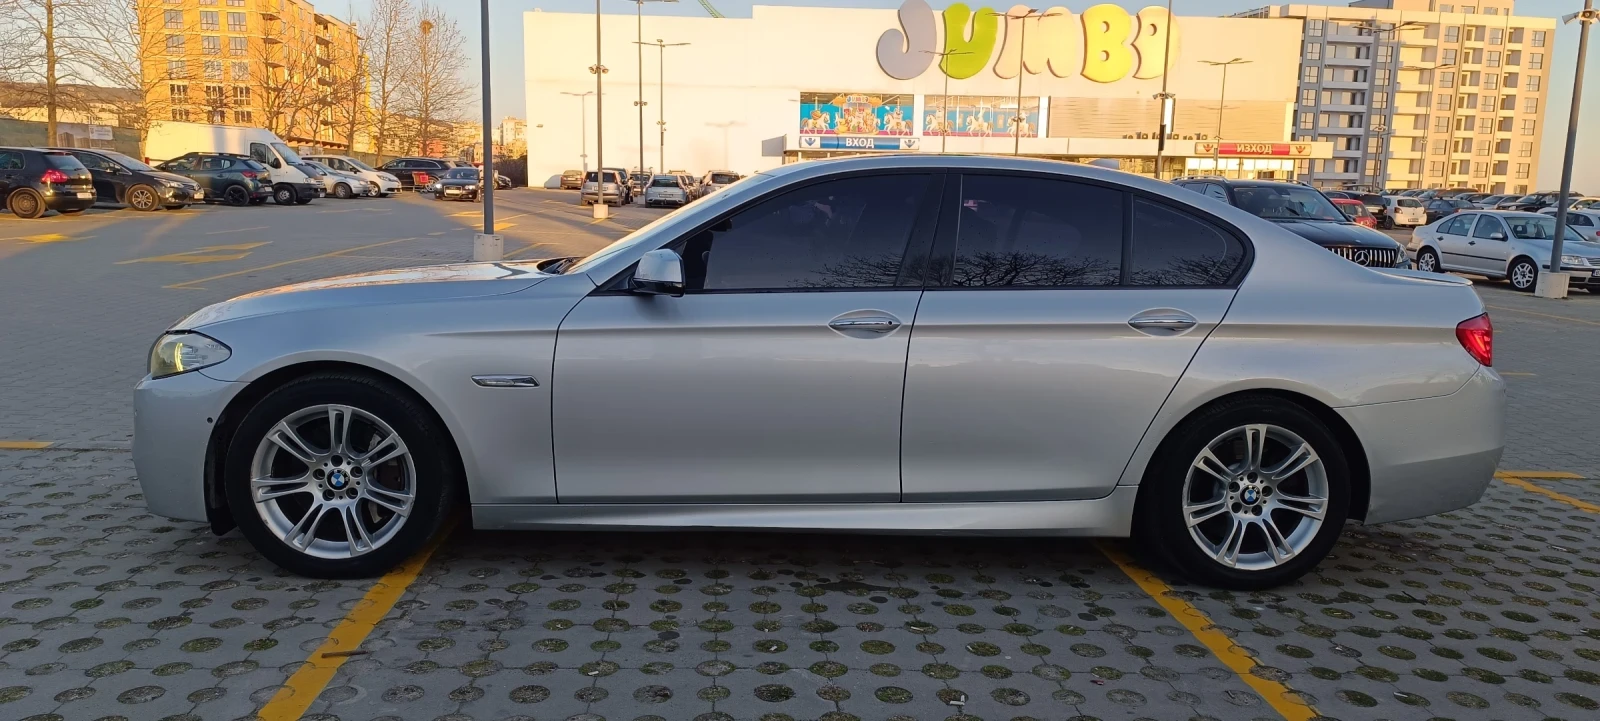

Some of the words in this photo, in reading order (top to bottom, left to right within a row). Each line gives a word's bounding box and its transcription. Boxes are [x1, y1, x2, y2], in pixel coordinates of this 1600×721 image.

[876, 0, 1181, 83] JUMBO
[846, 138, 874, 148] ВХОД
[1236, 144, 1272, 155] ИЗХОД
